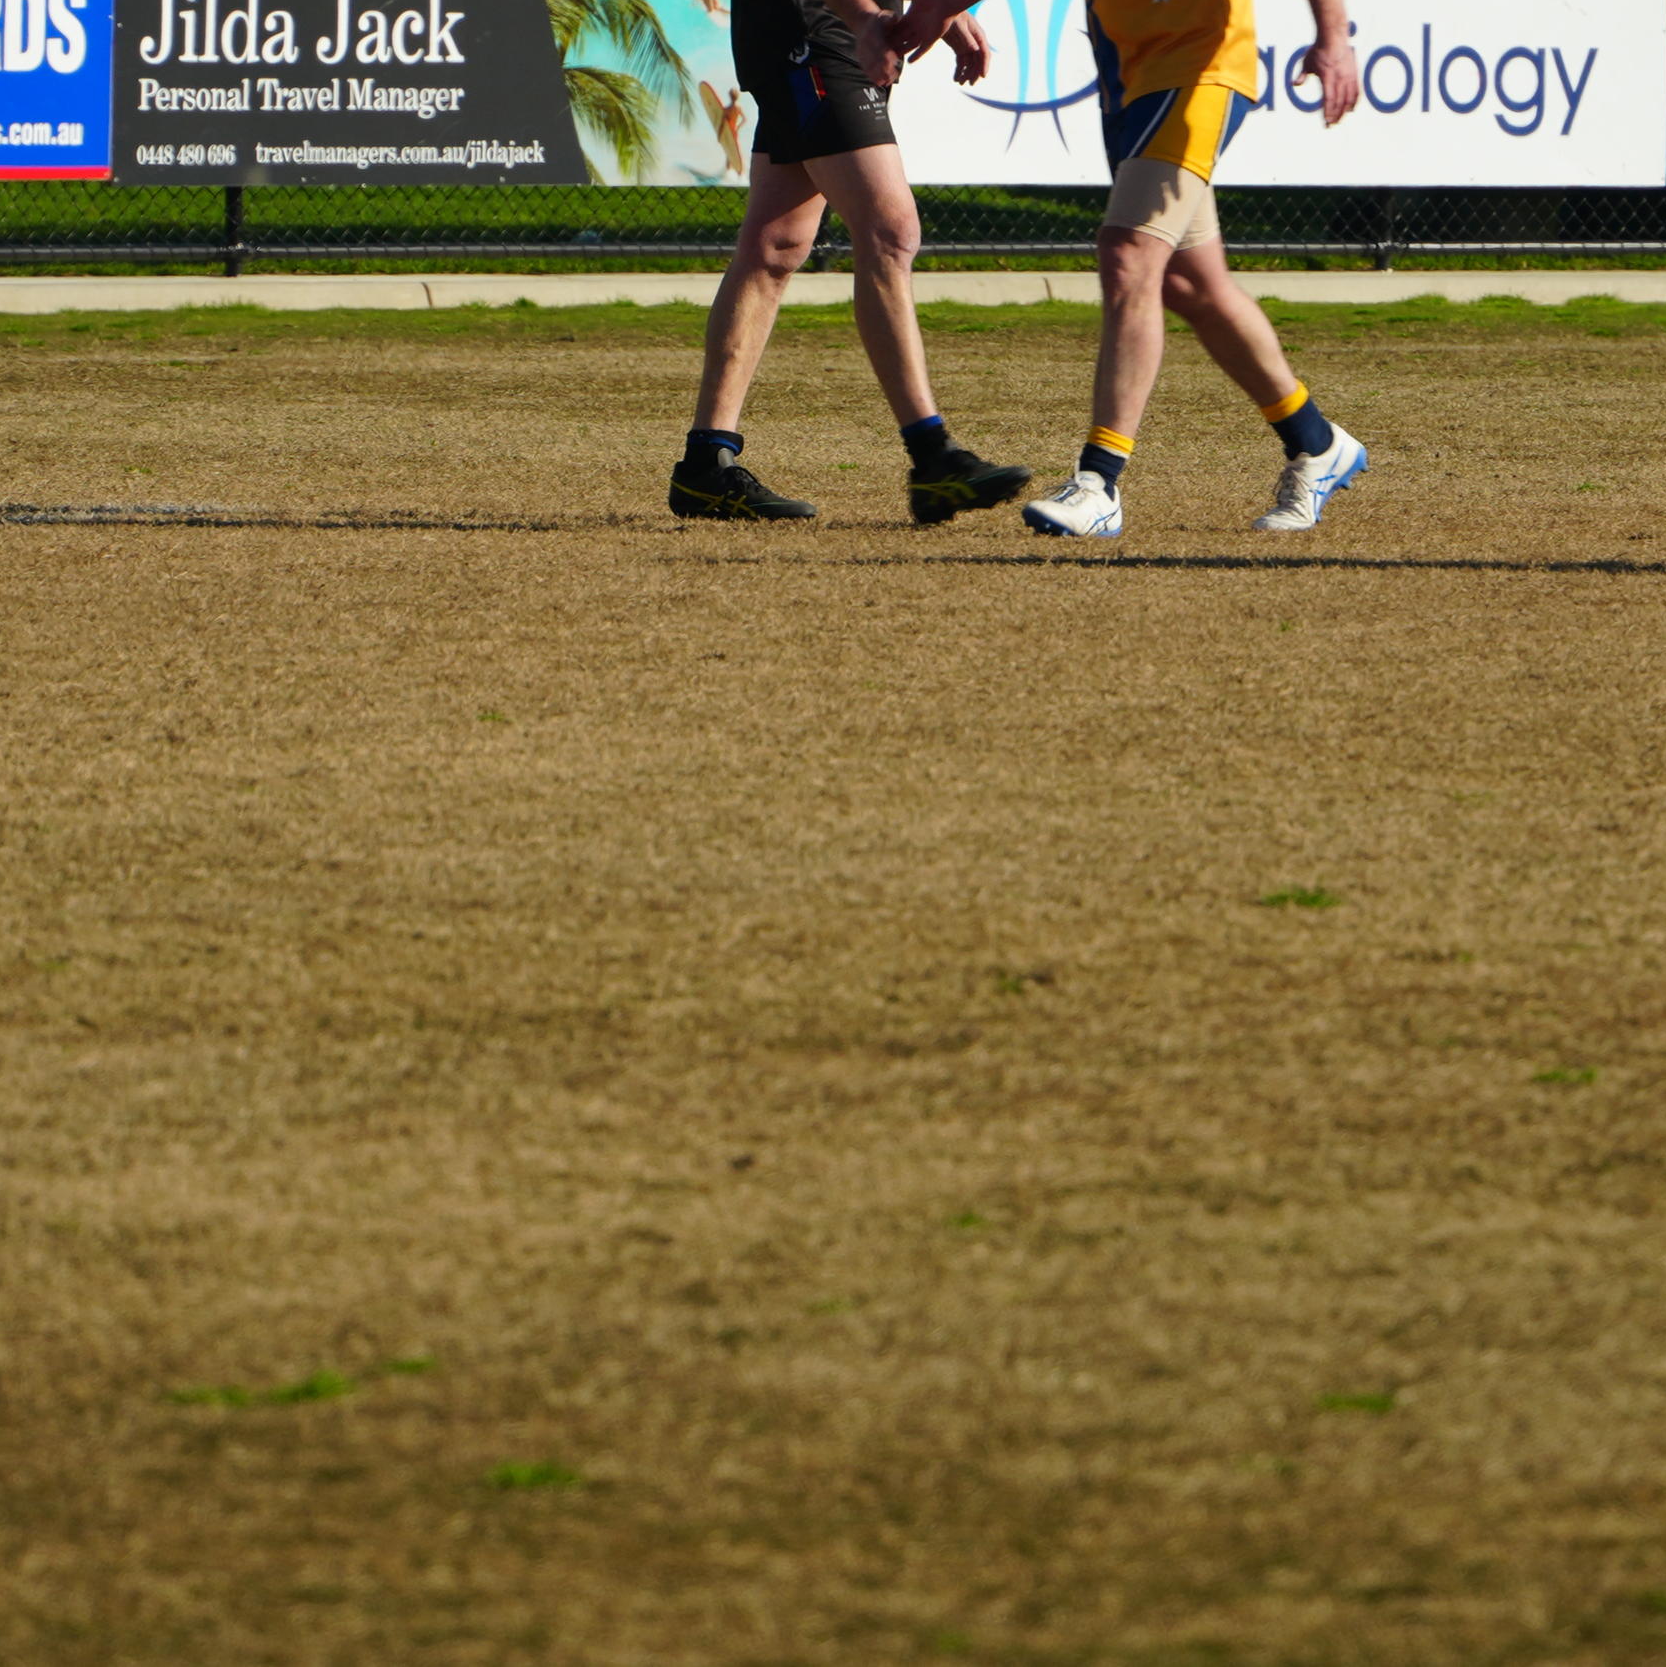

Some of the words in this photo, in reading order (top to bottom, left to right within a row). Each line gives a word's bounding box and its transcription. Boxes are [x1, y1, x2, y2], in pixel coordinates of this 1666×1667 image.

[138, 78, 250, 111] Personal
[257, 78, 340, 111] Travel
[347, 78, 464, 119] Manager
[137, 145, 175, 165] 0448
[176, 145, 205, 165] 480
[207, 145, 236, 165] 696
[255, 140, 545, 169] travelmanagers.com.au/jildajack
